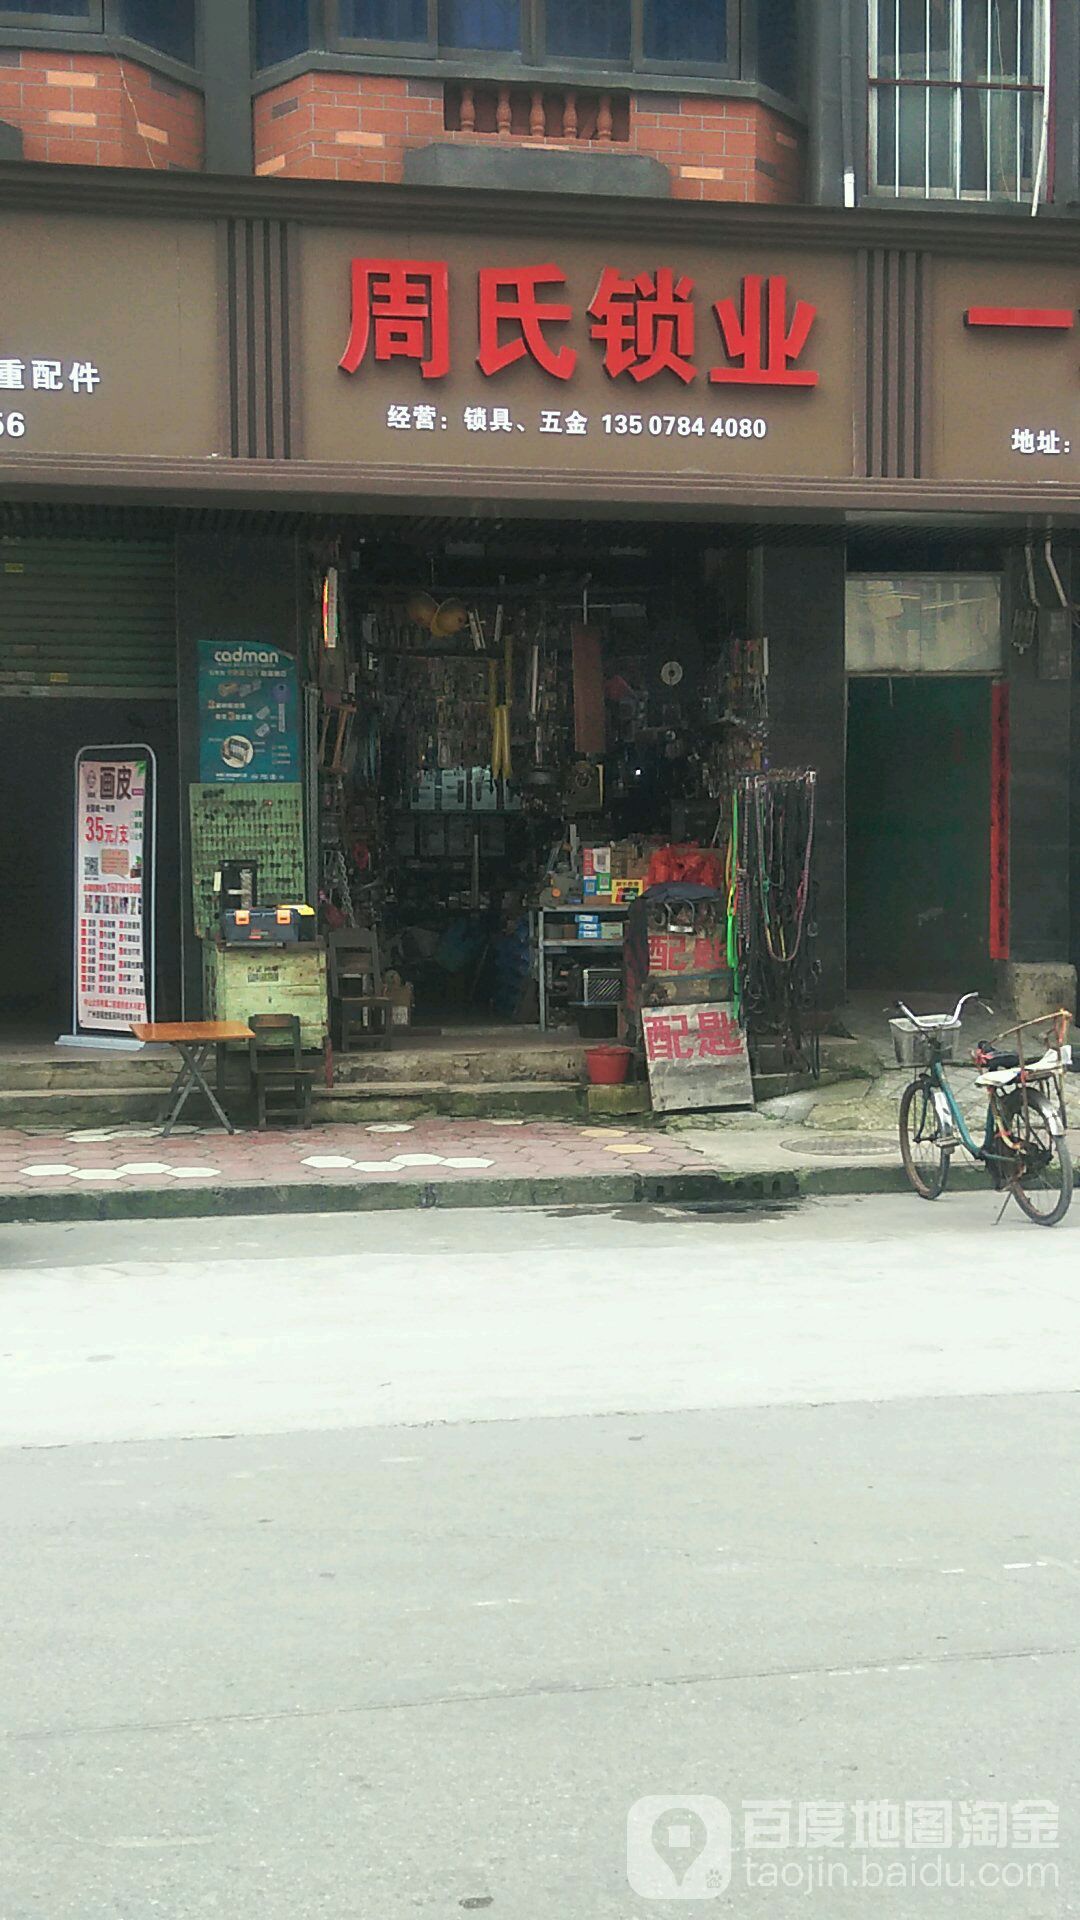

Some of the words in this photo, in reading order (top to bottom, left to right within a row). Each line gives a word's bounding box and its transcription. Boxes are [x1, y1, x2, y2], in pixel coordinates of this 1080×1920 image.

[338, 258, 819, 386] 周氏锁业
[0, 358, 101, 393] 重配件
[0, 411, 25, 437] 6
[214, 647, 279, 662] cadman
[85, 816, 129, 844] 35元/支
[644, 1012, 744, 1061] 配匙
